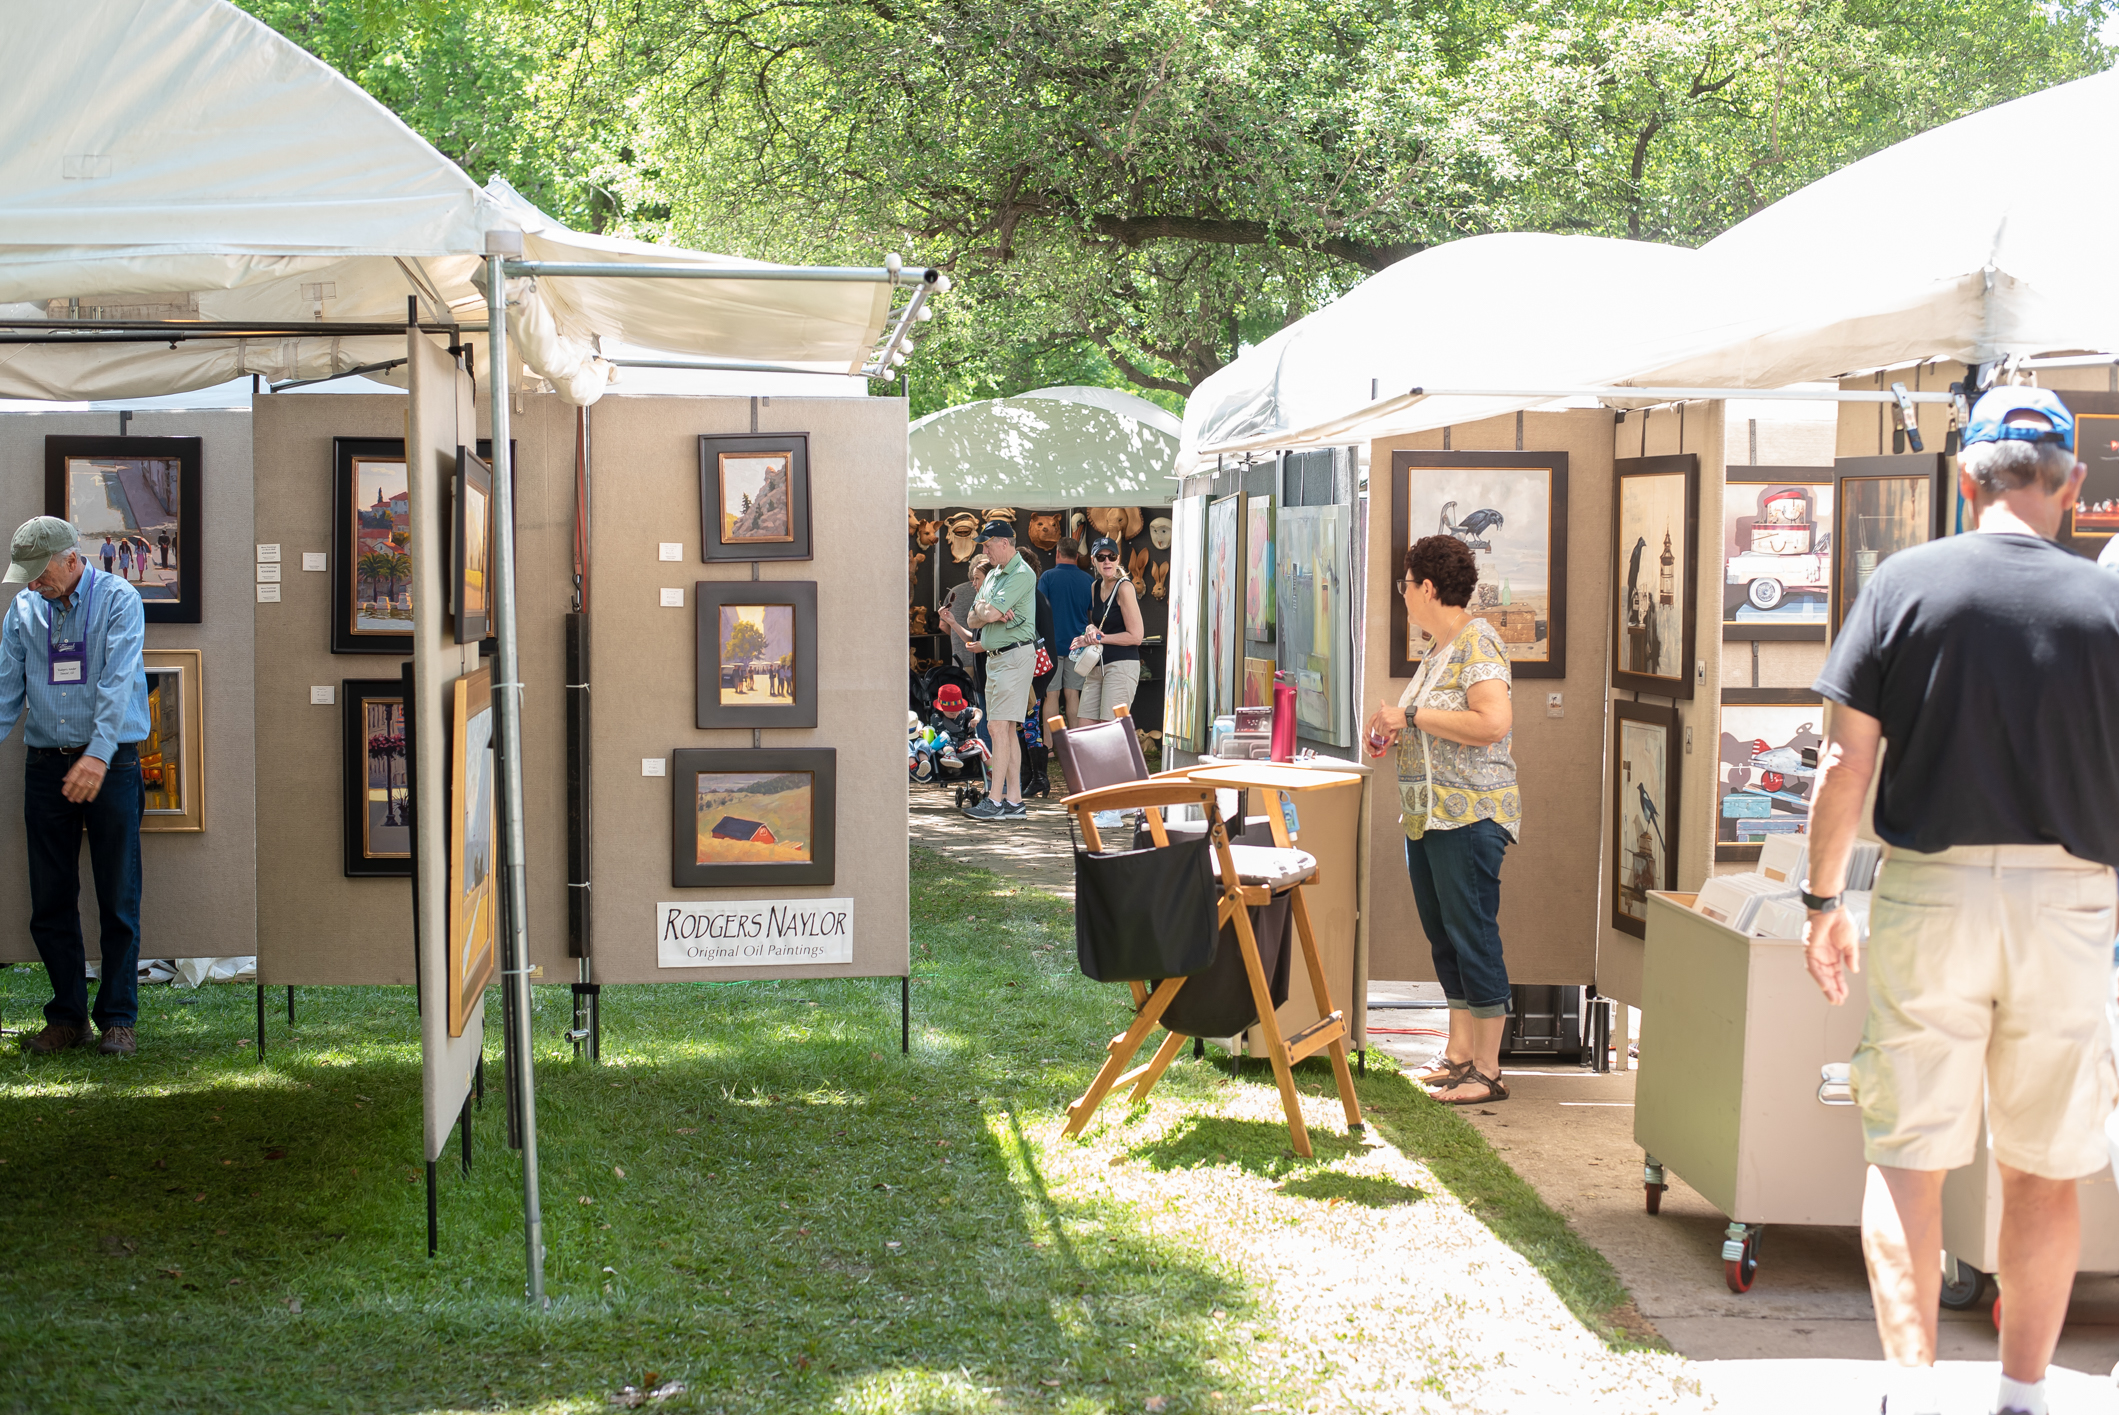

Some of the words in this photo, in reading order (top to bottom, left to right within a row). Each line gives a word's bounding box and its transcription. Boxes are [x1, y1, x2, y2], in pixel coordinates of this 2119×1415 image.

[663, 908, 763, 942] RODGERS
[766, 905, 848, 939] NAYLOR
[687, 945, 740, 961] Original
[743, 944, 764, 957] Oil
[767, 944, 825, 959] Paintings
